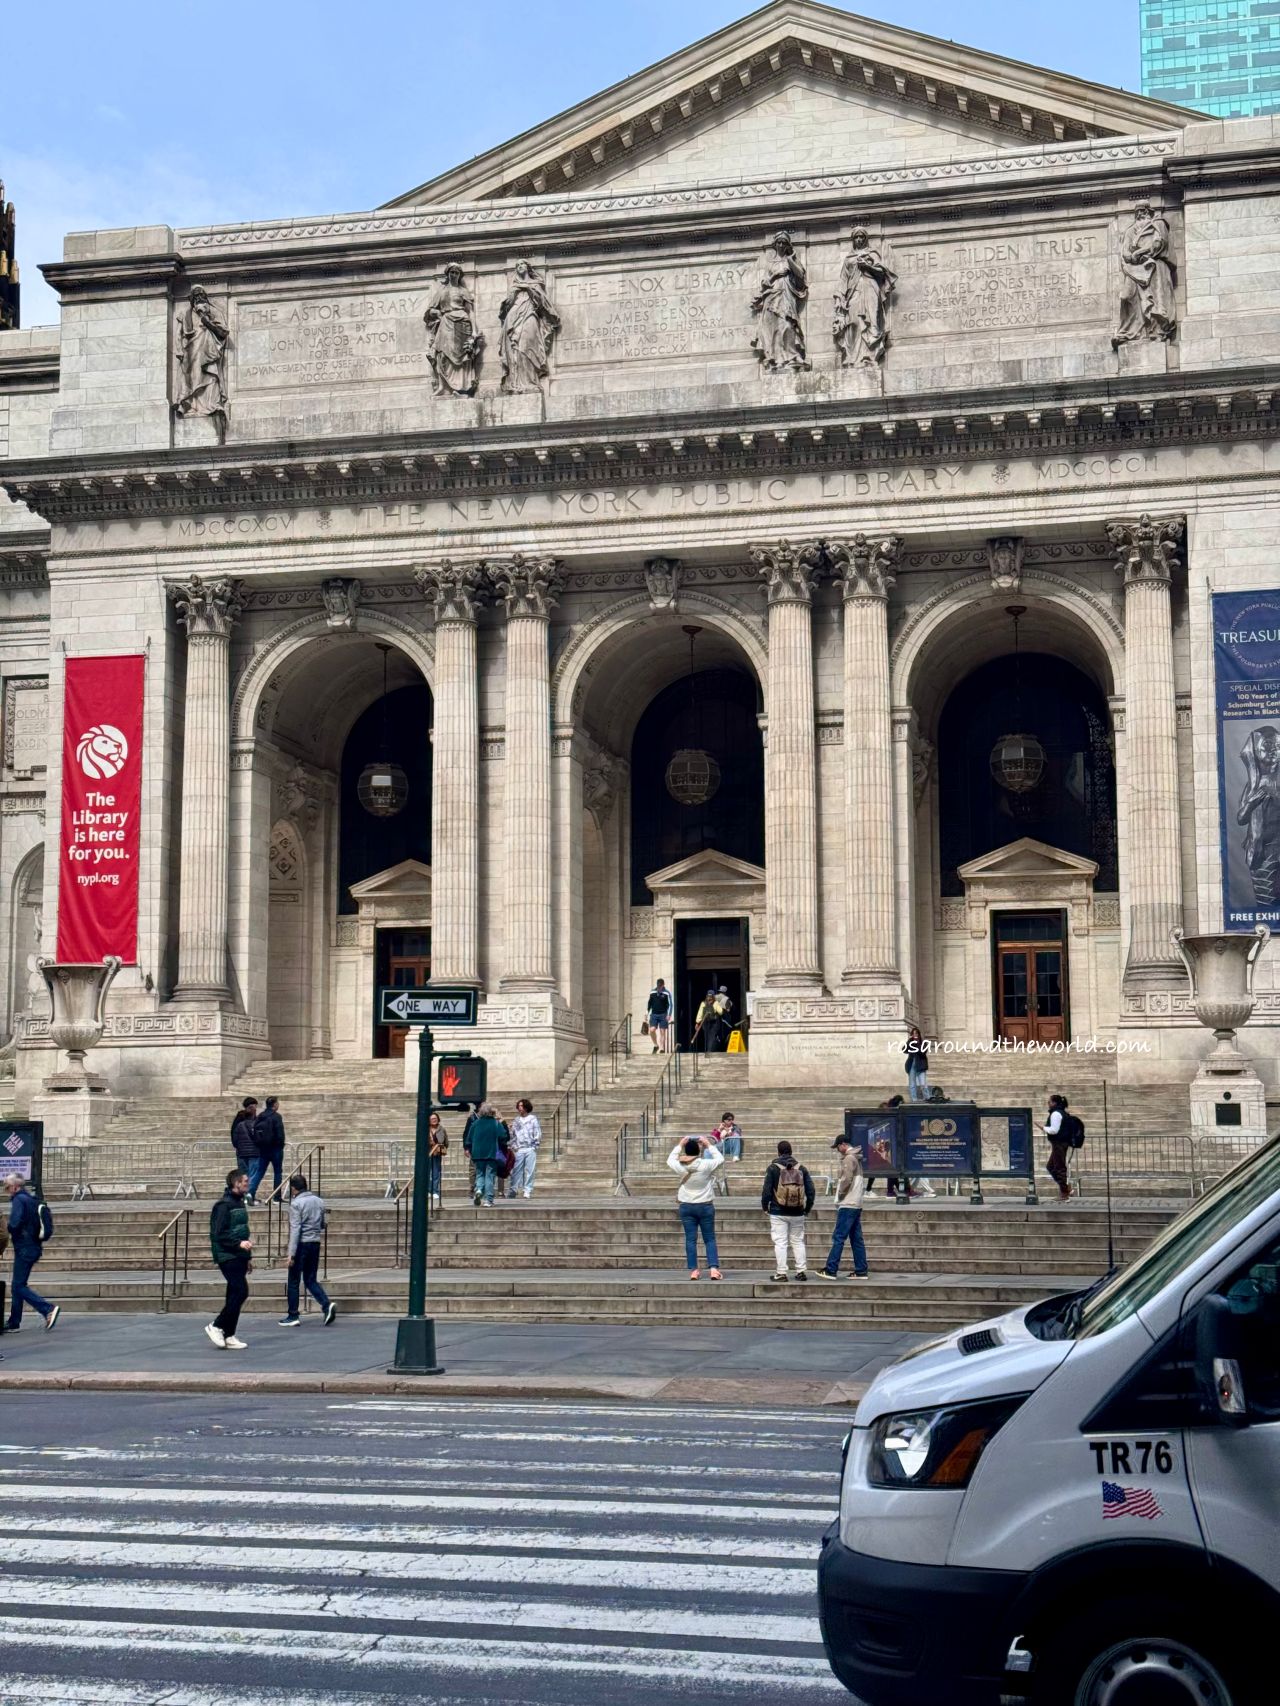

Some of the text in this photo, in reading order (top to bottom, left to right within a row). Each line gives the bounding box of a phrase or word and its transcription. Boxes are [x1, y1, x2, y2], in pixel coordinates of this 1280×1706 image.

[903, 236, 1096, 268] THE TILDEN TRUST
[960, 265, 1038, 280] FOUNDED BY
[566, 282, 598, 298] THE
[675, 269, 747, 290] LIBRARY
[924, 272, 1077, 296] SAMUEL JONES TILDEN
[620, 296, 692, 310] FOUNDED BY
[936, 298, 968, 308] SERVE
[976, 294, 996, 304] THE
[1002, 288, 1062, 300] INTERESTS
[1069, 286, 1082, 295] OF
[249, 298, 418, 324] THE ASTOR LIBRARY
[606, 306, 706, 324] JAMES LENOX
[903, 310, 948, 322] SCIENCE
[955, 308, 976, 318] AND
[982, 302, 1031, 316] POPULAR
[300, 324, 367, 336] FOUNDED BY
[590, 318, 722, 336] DEDICATED TO HISTORY
[271, 332, 395, 351] JOHN JACOB ASTOR
[564, 327, 748, 350] LITERATURE AND THE FINE ARTS
[310, 348, 354, 359] FOR THE
[246, 354, 422, 376] ADVANCEMENT OF USEFUL KNOWLEDGE
[358, 502, 426, 528] THE
[450, 496, 528, 523] NEW
[557, 488, 642, 515] YORK
[671, 478, 788, 508] PUBLIC
[819, 465, 964, 498] LIBRARY
[1230, 684, 1262, 692] SPECIAL
[16, 709, 37, 718] OLD
[86, 792, 115, 806] The
[72, 810, 128, 828] Library
[75, 827, 125, 842] is here
[68, 846, 130, 864] for you.
[78, 872, 120, 886] nypl.org
[1230, 913, 1254, 922] FREE
[396, 1000, 460, 1012] ONE WAY
